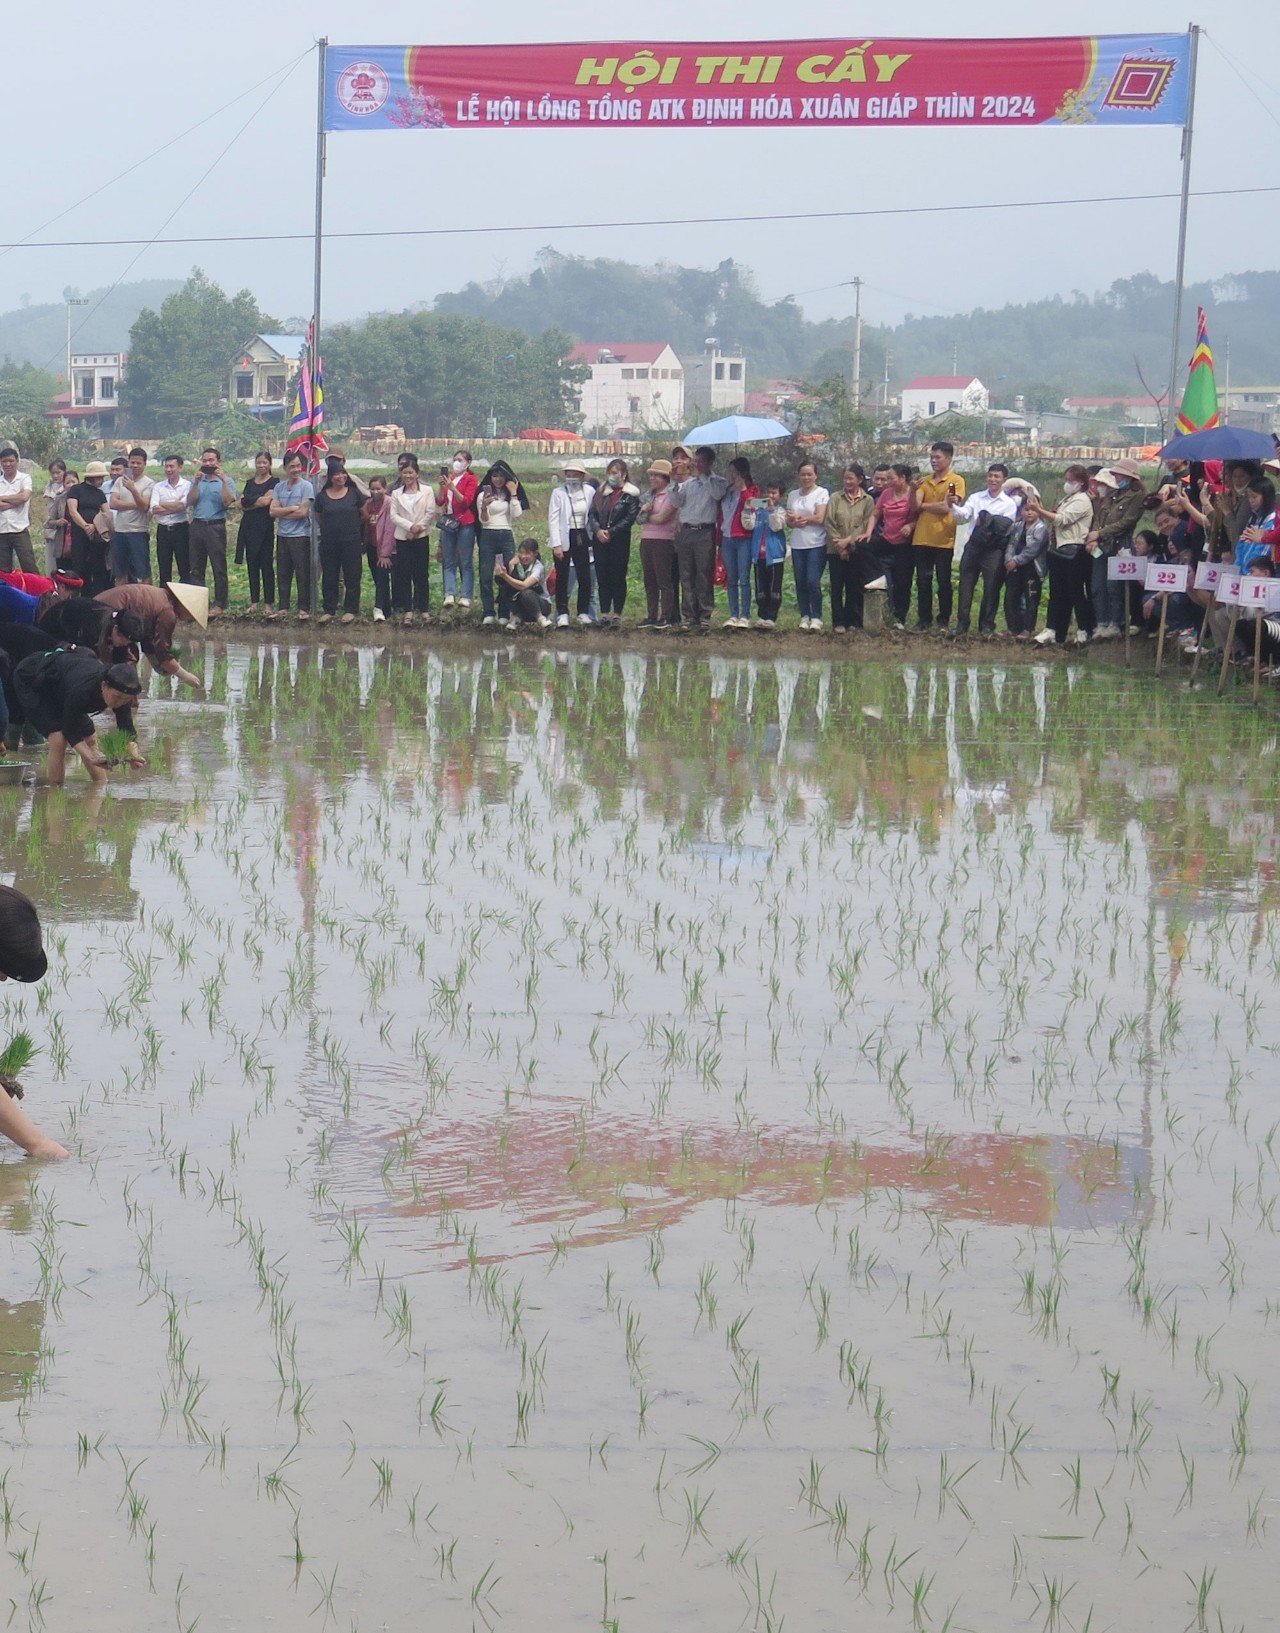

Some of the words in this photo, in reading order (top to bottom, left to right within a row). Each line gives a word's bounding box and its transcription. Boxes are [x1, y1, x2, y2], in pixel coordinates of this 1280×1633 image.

[574, 49, 682, 94] HỘI
[695, 55, 784, 84] THI
[796, 40, 913, 83] CẤY
[456, 92, 480, 121] LỄ
[486, 95, 521, 126] HỘI
[526, 92, 581, 121] LỒNG
[648, 98, 686, 121] ATK
[692, 98, 744, 125] ĐỊNH
[750, 93, 792, 120] HÓA
[800, 93, 860, 120] XUÂN
[866, 92, 918, 119] GIÁP
[925, 92, 976, 119] THÌN
[981, 96, 1036, 118] 2024
[1118, 562, 1137, 574] 23
[1157, 571, 1177, 584] 22
[1207, 569, 1218, 583] 2
[1230, 582, 1240, 596] 2
